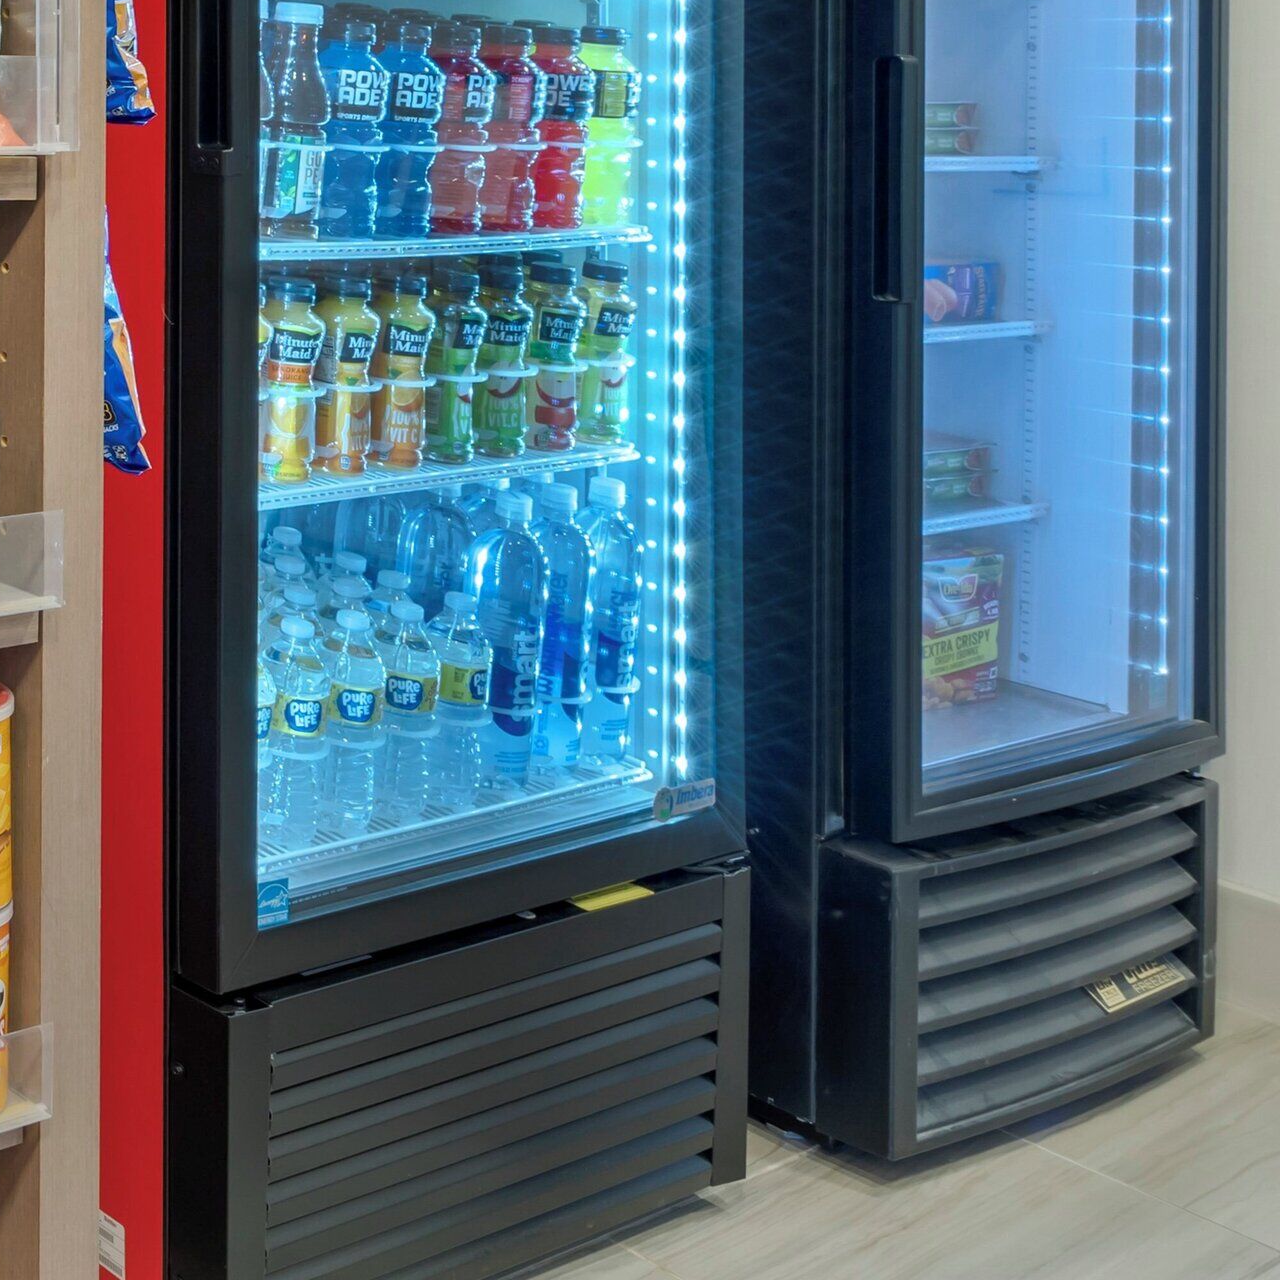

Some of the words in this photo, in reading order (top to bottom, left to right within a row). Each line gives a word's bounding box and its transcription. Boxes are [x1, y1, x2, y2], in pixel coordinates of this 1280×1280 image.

[338, 89, 382, 107] ADE
[279, 347, 314, 361] Maid
[923, 639, 953, 659] EXTRA
[955, 628, 992, 650] CRISPY
[512, 631, 539, 723] smart
[674, 783, 715, 806] Imbera
